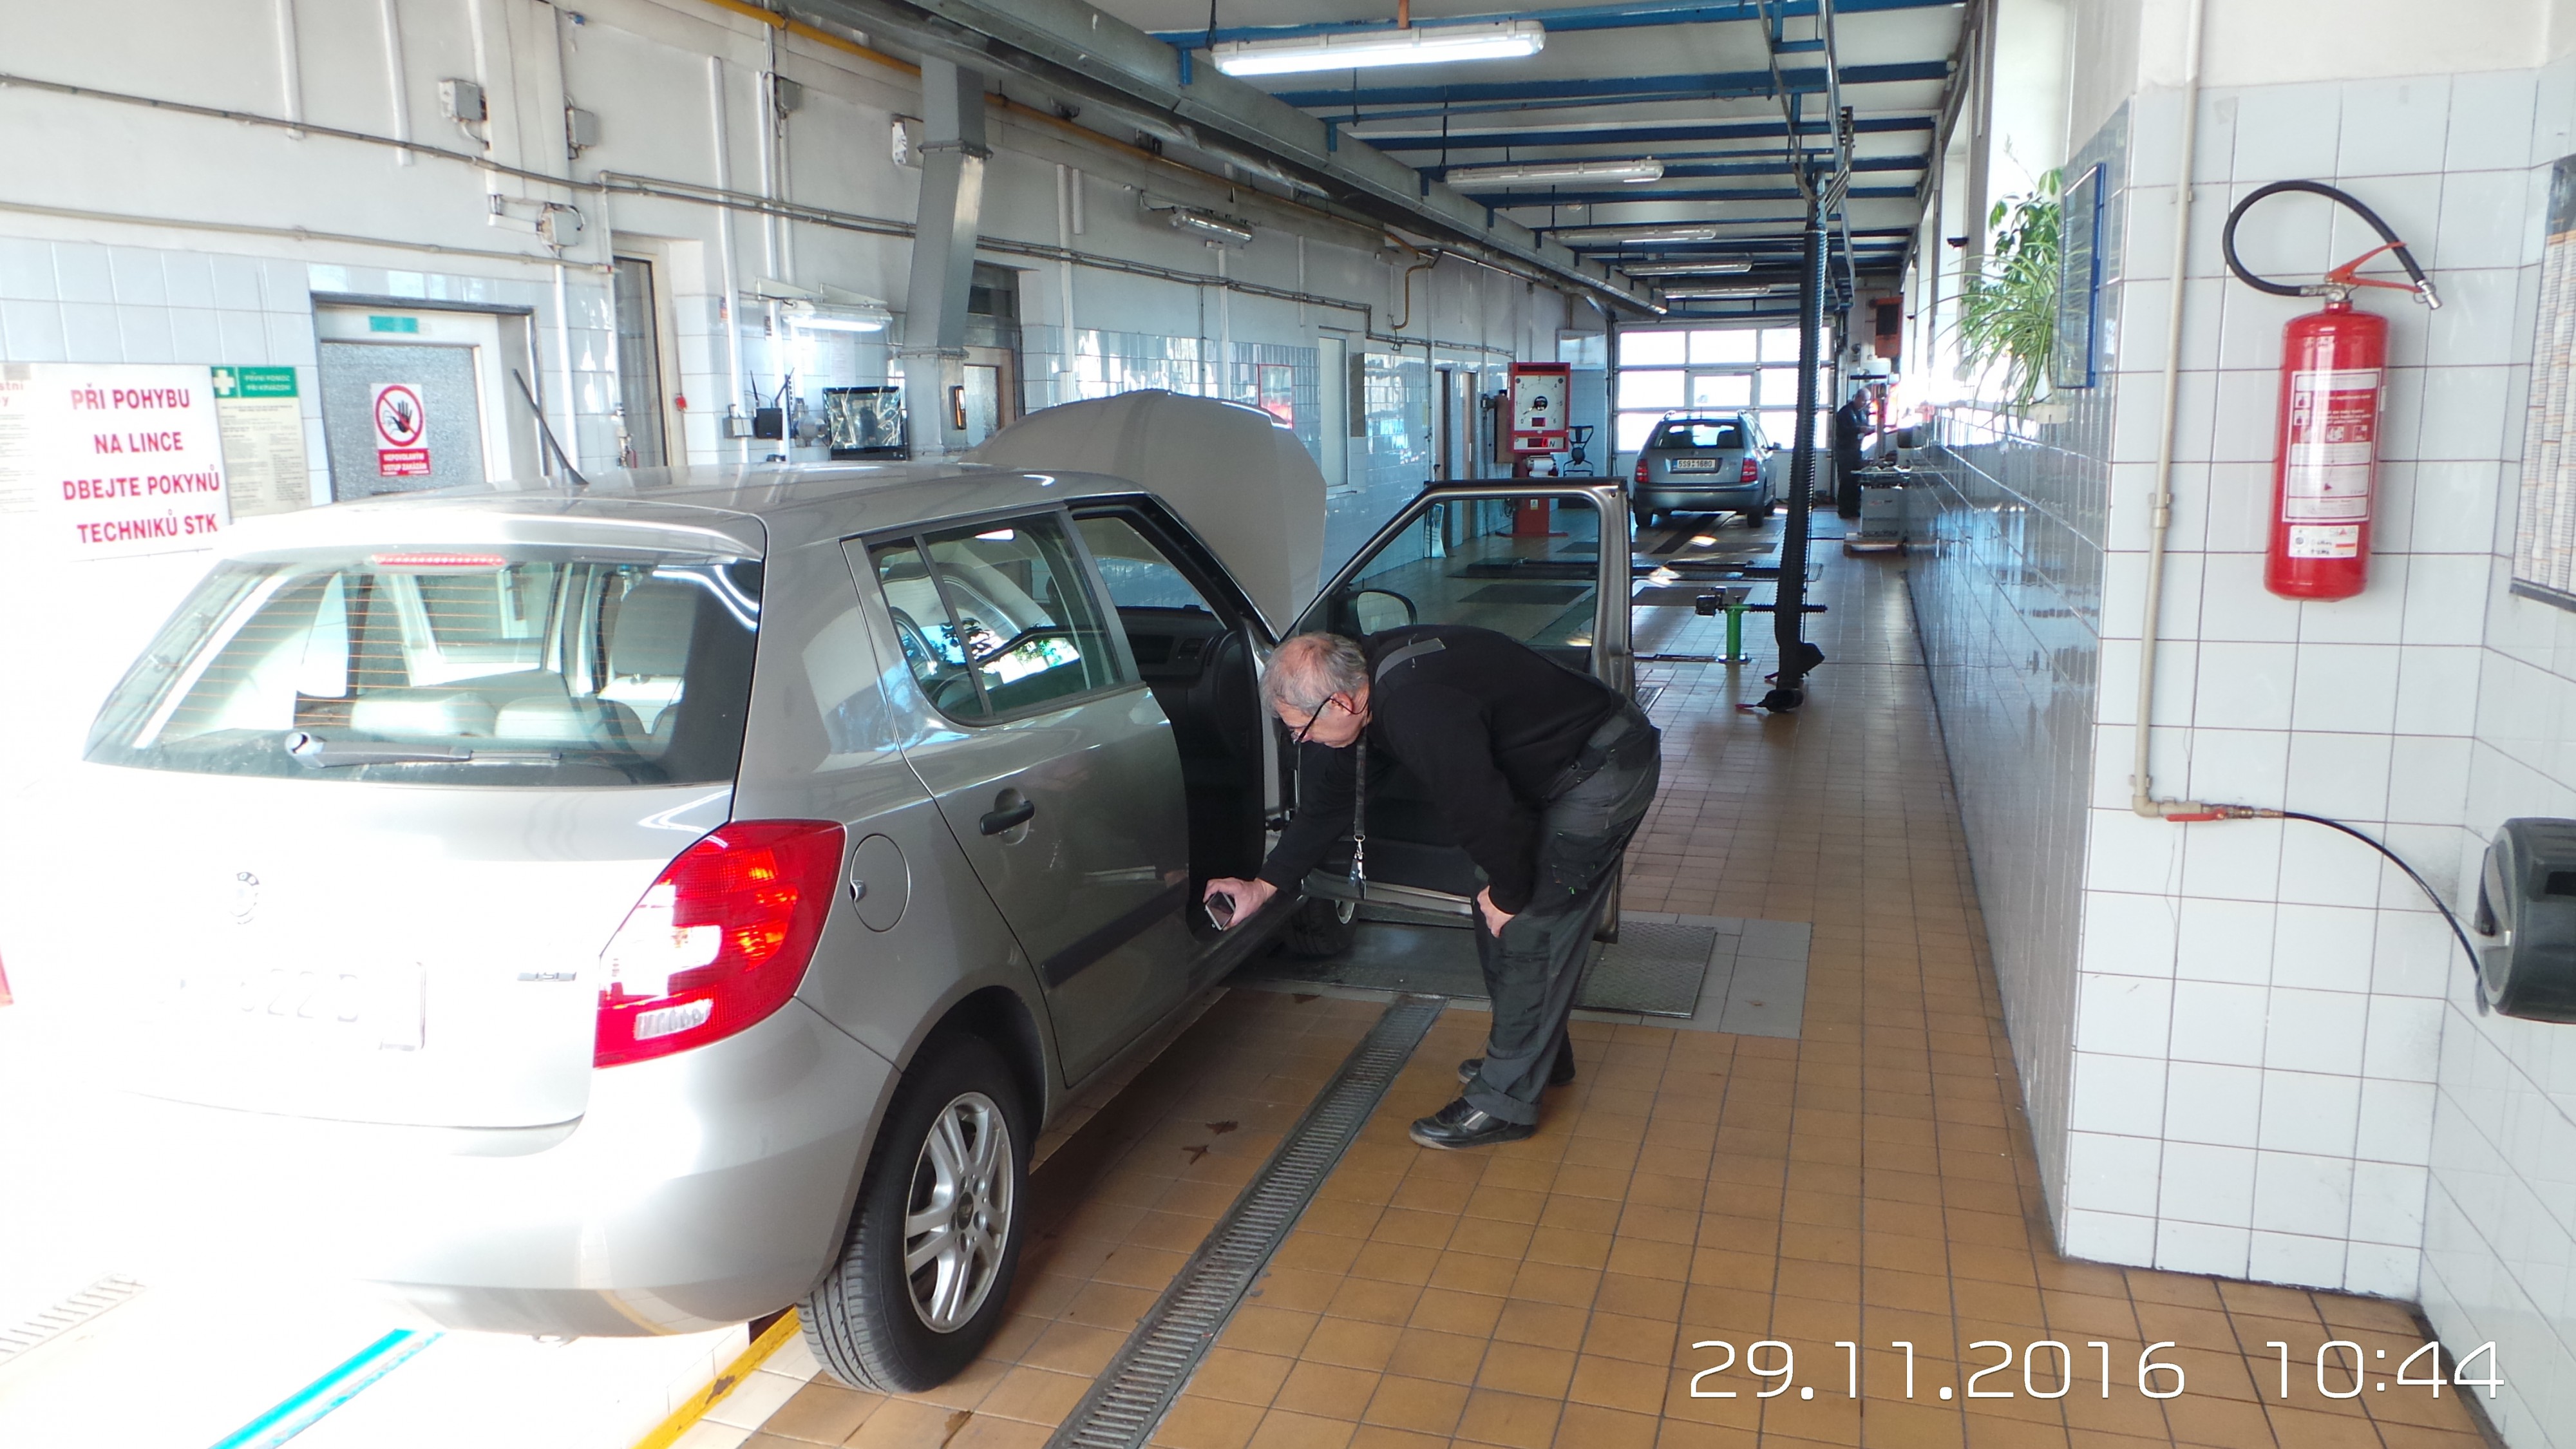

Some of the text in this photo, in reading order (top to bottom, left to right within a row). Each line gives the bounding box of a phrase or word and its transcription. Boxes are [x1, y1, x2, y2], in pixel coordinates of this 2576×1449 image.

[71, 383, 191, 410] PŘI POHYBU
[93, 431, 184, 454] NA LINCE
[62, 464, 221, 500] DBEJTE POKYNŮ
[76, 509, 218, 544] TECHNIKŮ STK
